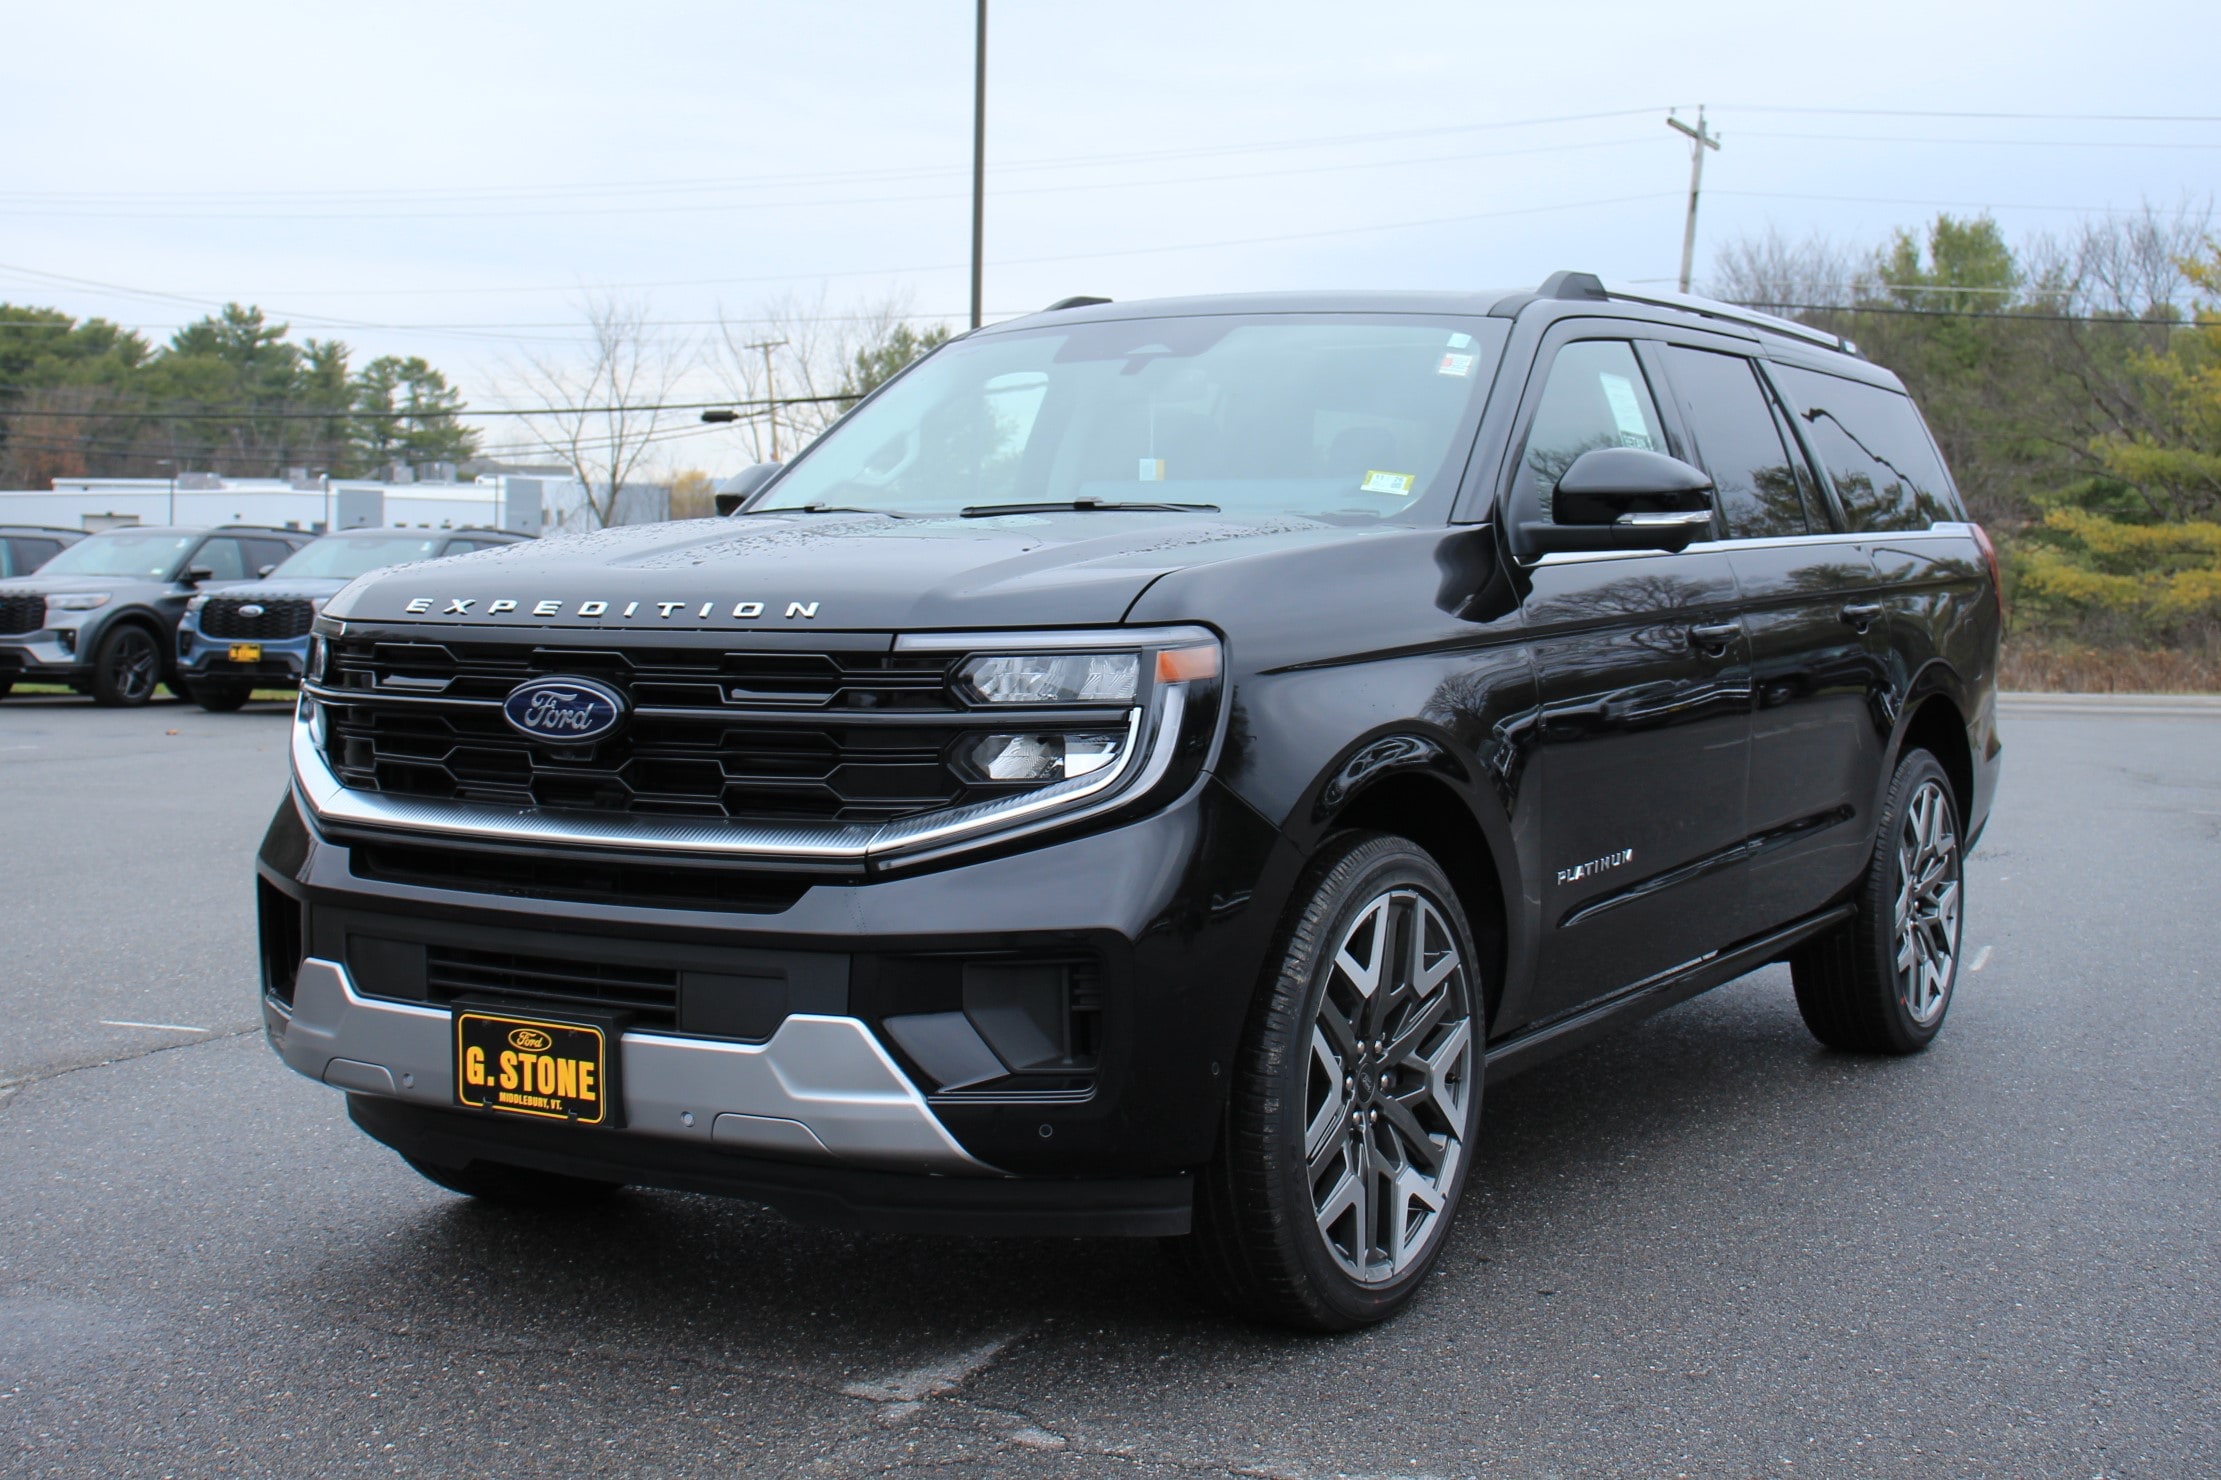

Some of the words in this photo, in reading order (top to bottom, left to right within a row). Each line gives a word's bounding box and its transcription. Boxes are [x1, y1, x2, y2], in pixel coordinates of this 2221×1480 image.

[404, 598, 820, 618] EXPEDITION
[524, 690, 595, 730] Ford
[1557, 848, 1633, 885] PLATINUM
[516, 1031, 543, 1048] Ford
[466, 1046, 495, 1087] G.
[499, 1050, 596, 1101] STONE
[498, 1091, 550, 1110] MIDDLEBURY,
[550, 1098, 563, 1110] VT.
